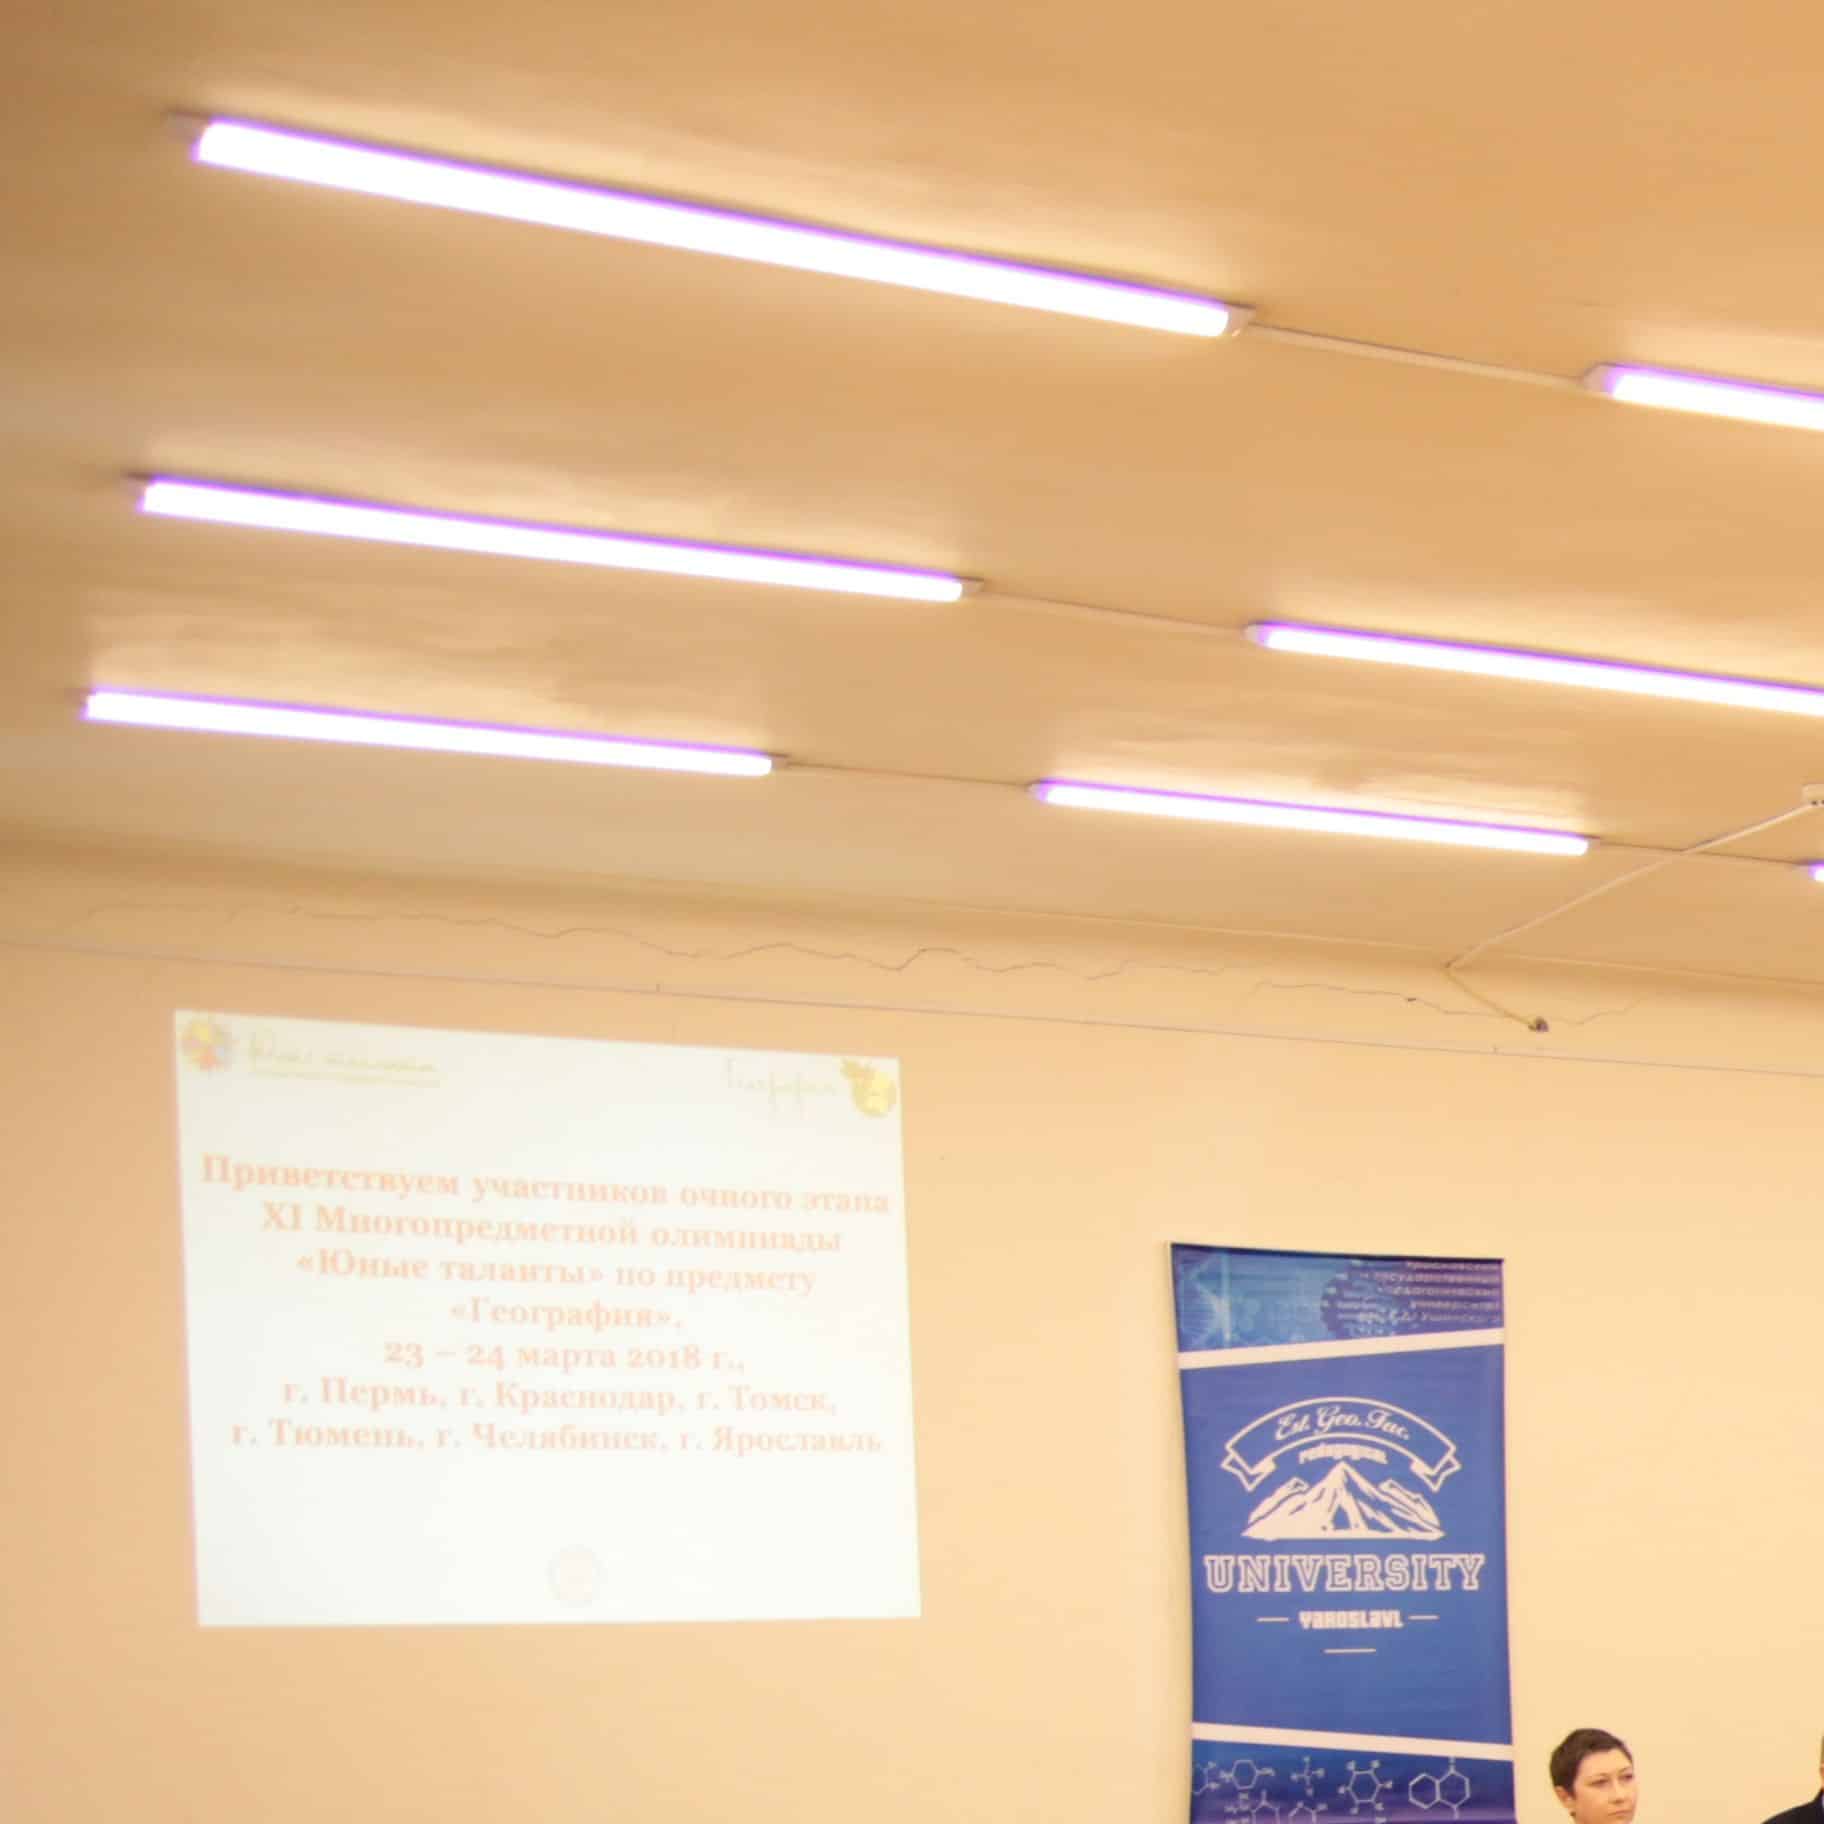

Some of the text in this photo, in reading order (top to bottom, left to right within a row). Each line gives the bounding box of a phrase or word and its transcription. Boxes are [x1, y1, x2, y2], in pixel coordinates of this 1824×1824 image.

[202, 1153, 890, 1214] Приветствуем участников очного этапа
[263, 1200, 840, 1253] XI Многопредметной олимпиады
[296, 1248, 816, 1296] «Юные таланты» по предмету
[384, 1342, 424, 1368] 23
[465, 1344, 506, 1371] 24
[516, 1347, 616, 1376] марта
[626, 1345, 702, 1370] 2018
[283, 1376, 835, 1416] г. Пермь, г. Краснодар, г. Томск,
[232, 1418, 882, 1457] г. Тюмень, г. Челябинск, г. Ярославль
[1203, 1553, 1486, 1593] UNIVERSITY
